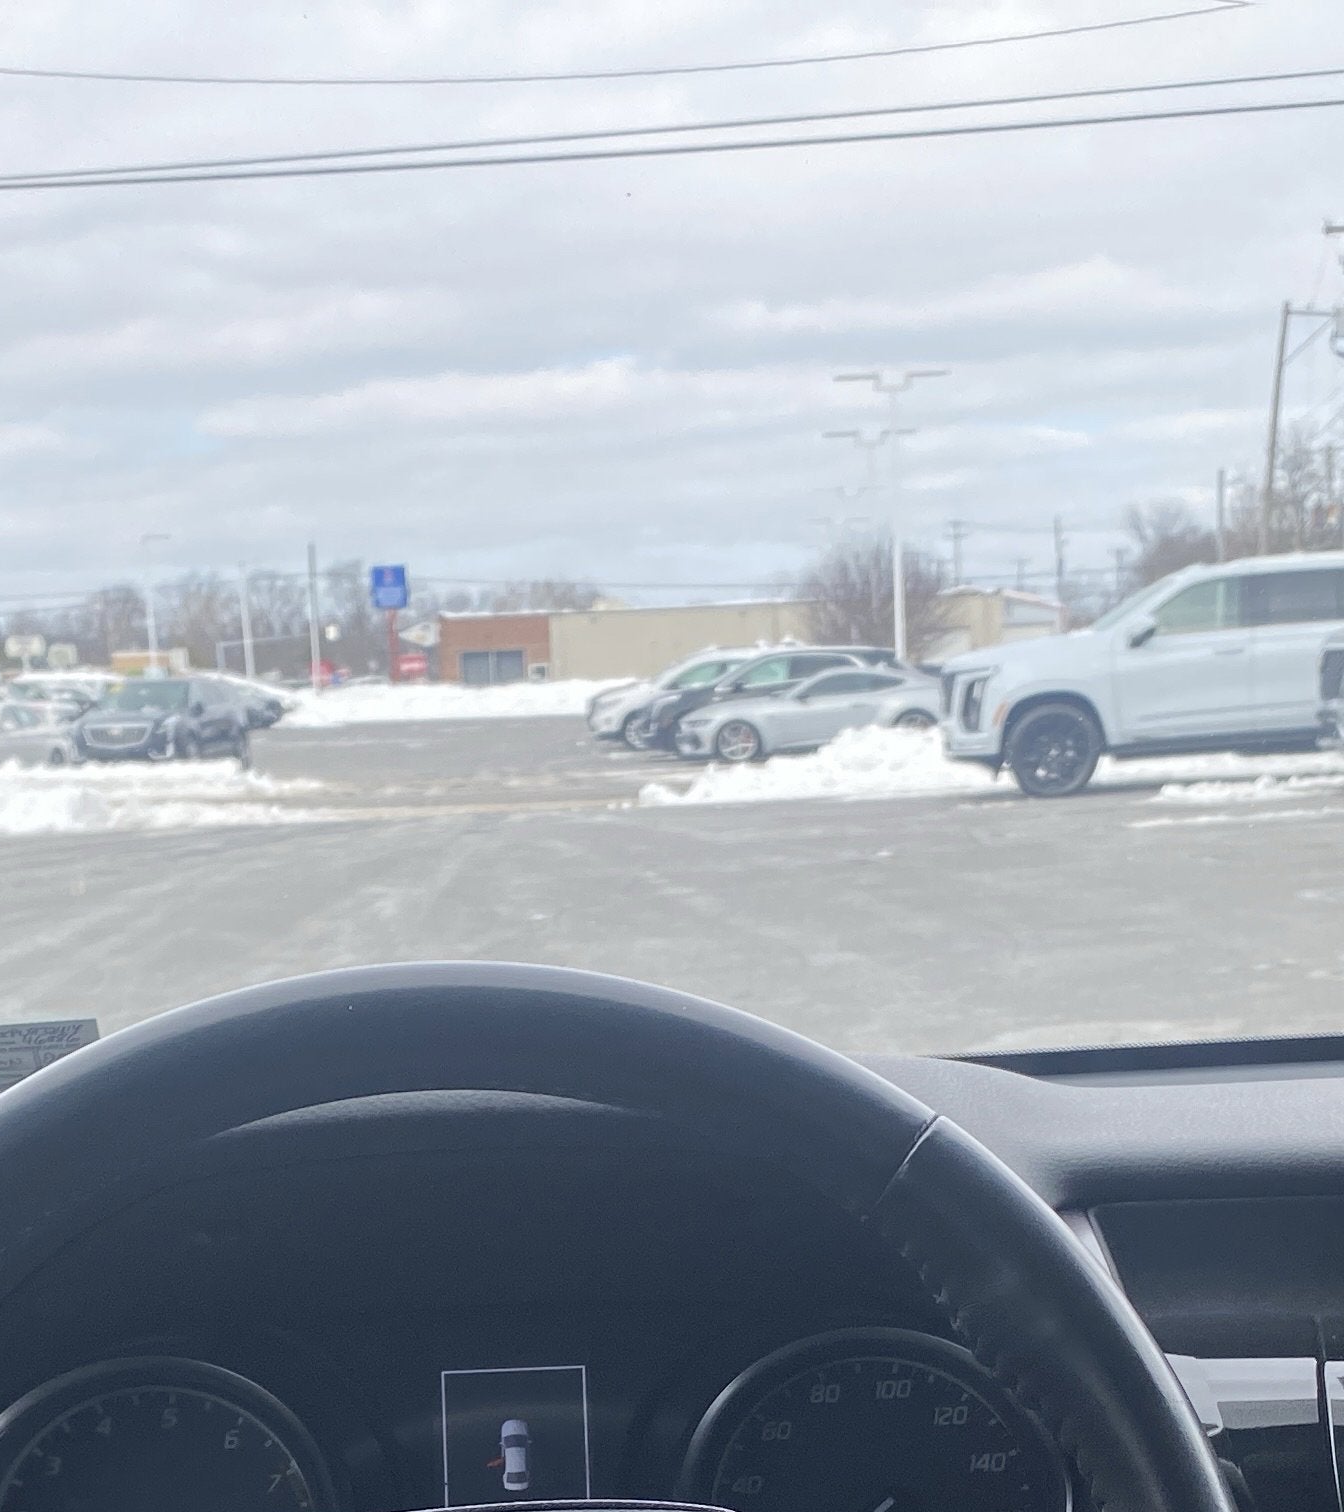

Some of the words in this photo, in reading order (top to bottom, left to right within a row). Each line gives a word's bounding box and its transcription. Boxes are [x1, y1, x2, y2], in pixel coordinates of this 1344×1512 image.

[810, 1384, 840, 1403] 80
[875, 1379, 911, 1399] 100
[933, 1405, 968, 1426] 120
[224, 1430, 240, 1450] 6
[761, 1421, 792, 1441] 60
[969, 1452, 1006, 1473] 140
